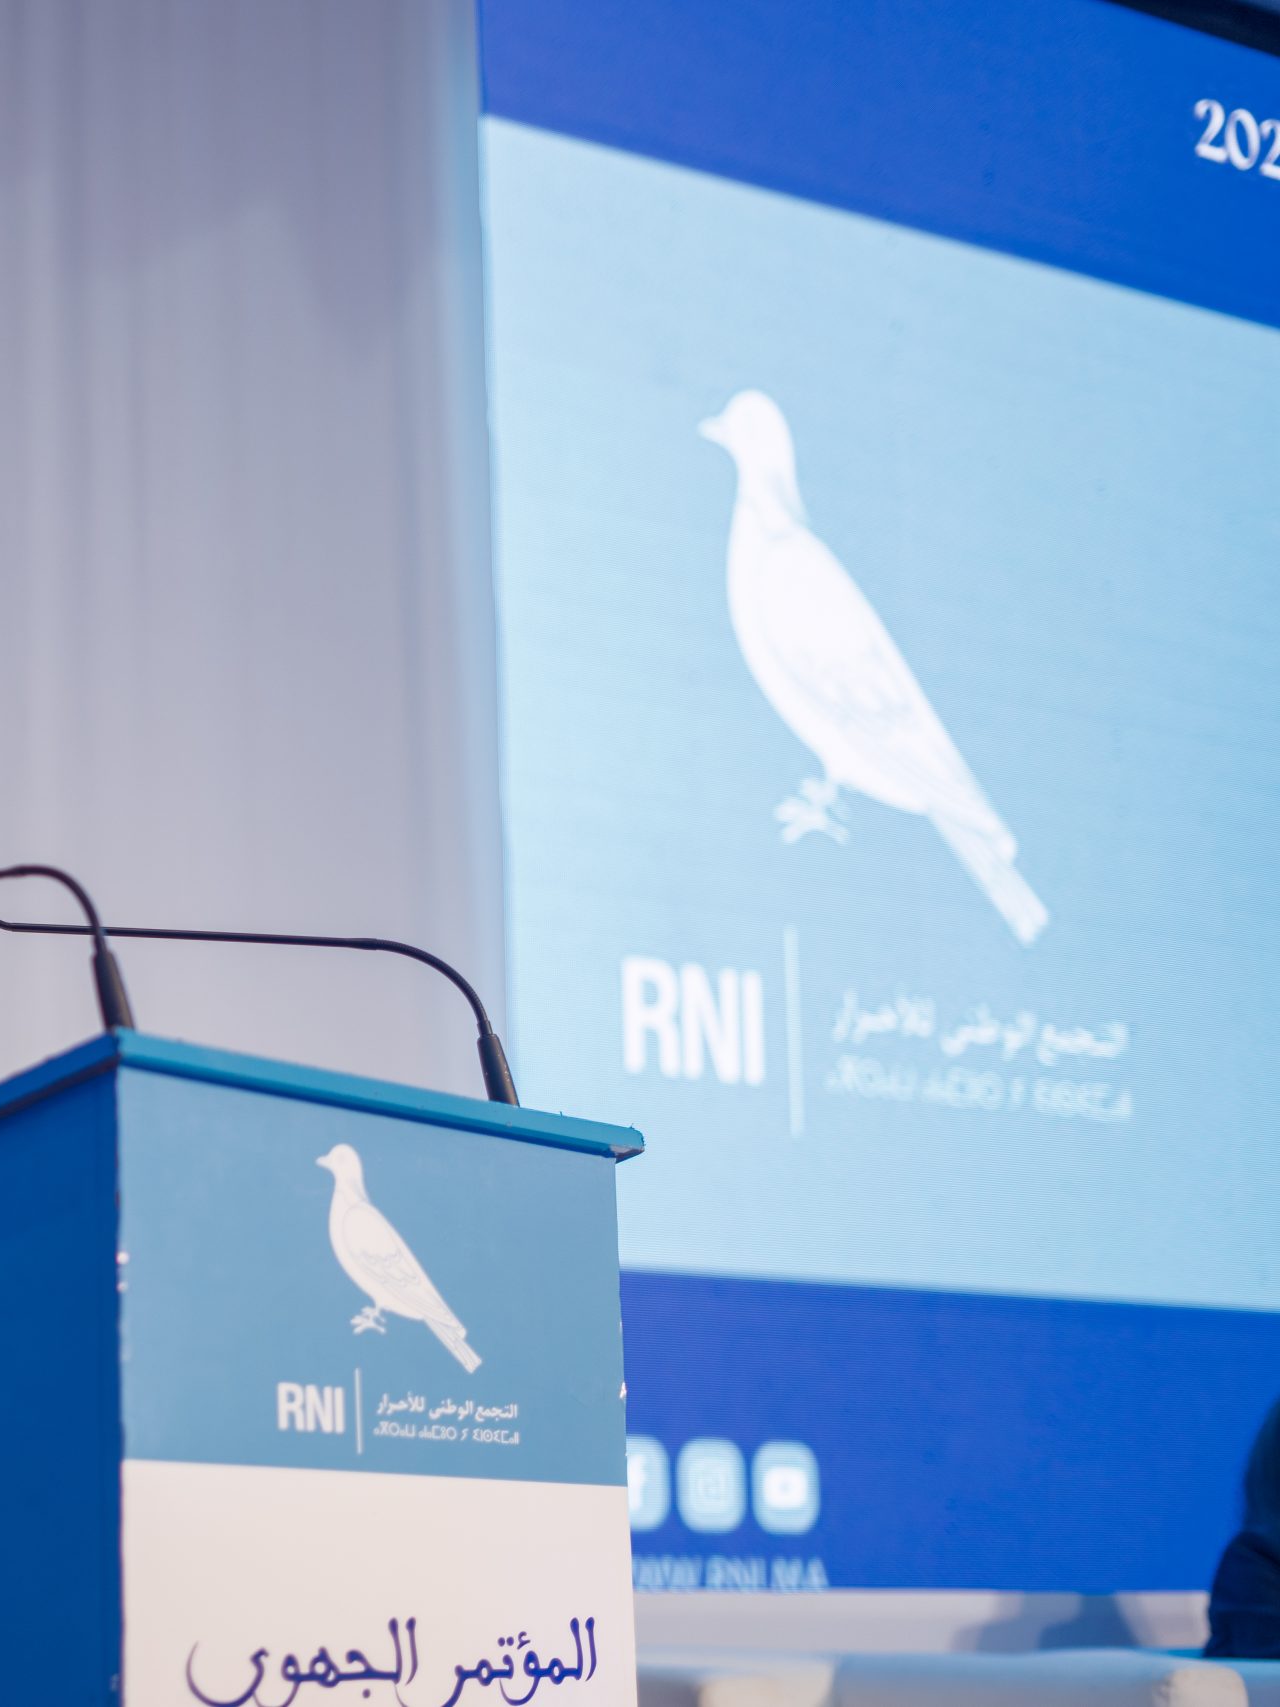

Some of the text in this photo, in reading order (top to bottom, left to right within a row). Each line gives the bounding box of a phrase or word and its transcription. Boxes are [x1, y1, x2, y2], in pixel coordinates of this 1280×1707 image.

[621, 955, 766, 1088] RNI
[276, 1381, 346, 1434] RNI
[474, 1402, 518, 1422] التجمع
[394, 1616, 597, 1707] المؤتمر
